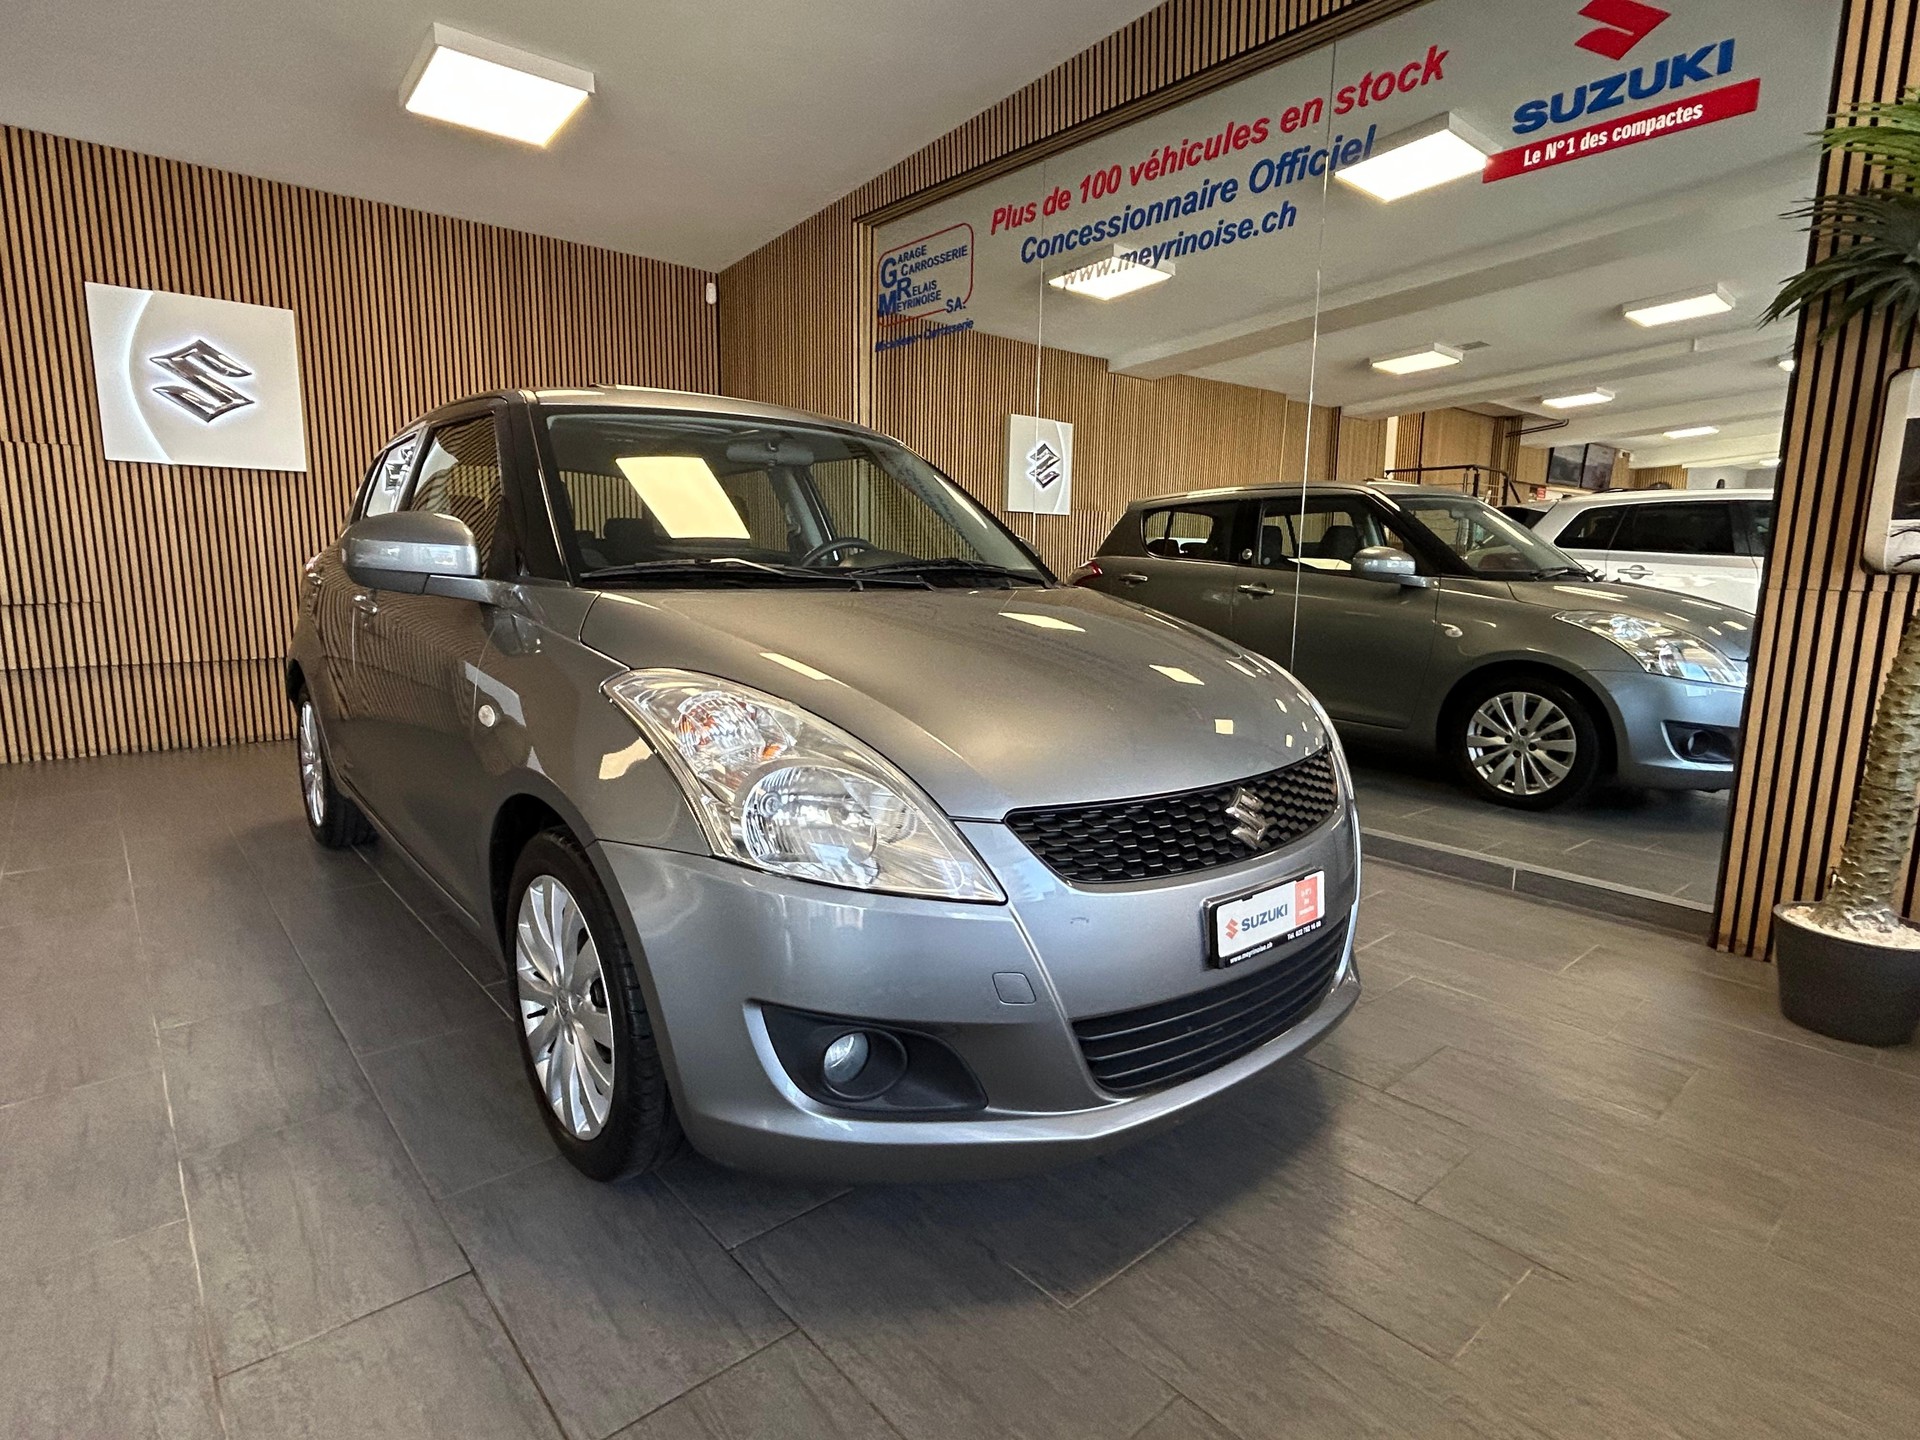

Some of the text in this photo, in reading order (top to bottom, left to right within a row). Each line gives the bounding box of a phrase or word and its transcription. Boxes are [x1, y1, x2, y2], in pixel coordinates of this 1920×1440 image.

[1512, 38, 1735, 135] SUZUKI
[991, 44, 1449, 235] Plus de 100 véhicules en stock
[1523, 149, 1541, 167] Le
[1579, 131, 1608, 151] des
[1612, 103, 1704, 142] compactes
[1020, 124, 1377, 264] Concessionnaire Officiel
[881, 245, 928, 289] GARAGE
[901, 244, 968, 276] CARROSSERIE
[1062, 201, 1297, 286] www.meyrinoise.ch
[879, 290, 942, 317] MEYRINOISE
[897, 277, 938, 301] RELAIS
[1241, 903, 1288, 932] SUZUKI
